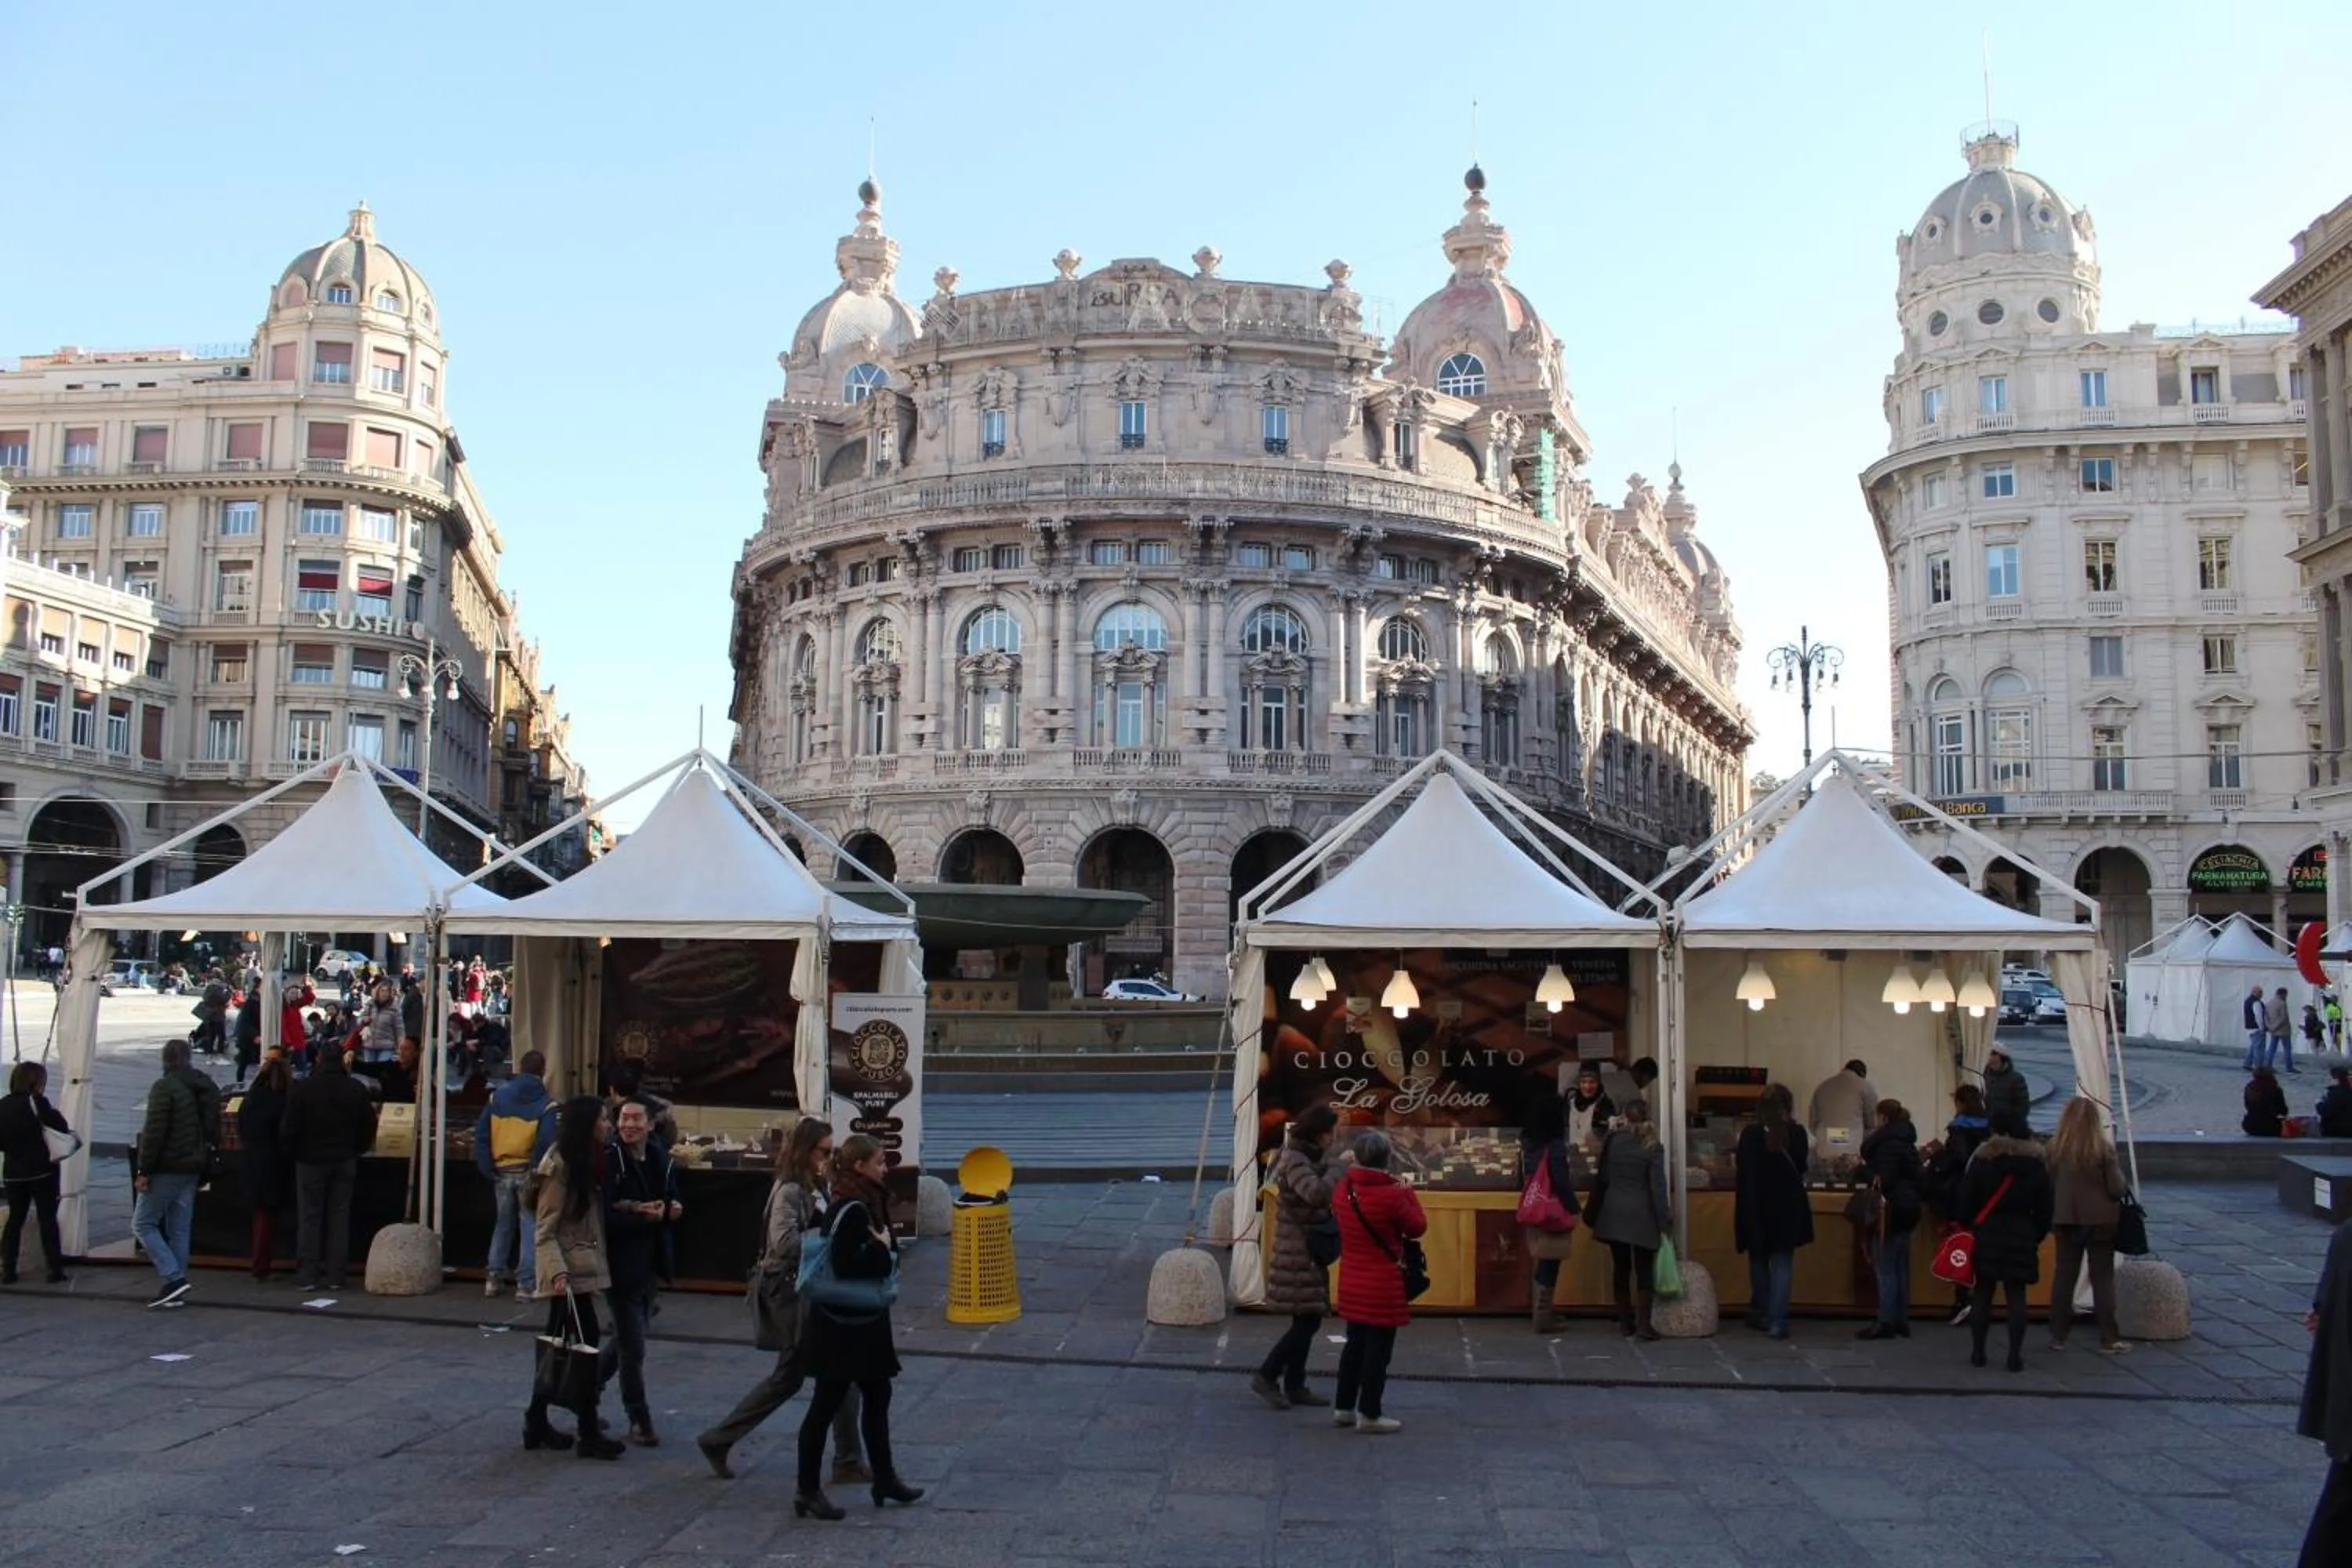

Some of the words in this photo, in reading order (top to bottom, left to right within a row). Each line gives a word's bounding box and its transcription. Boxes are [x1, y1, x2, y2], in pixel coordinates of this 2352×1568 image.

[316, 608, 403, 637] SUSHI
[1947, 801, 1987, 815] Banca
[851, 1022, 906, 1060] CIOCCOLATO
[1294, 1048, 1526, 1069] CIOCCOLATO
[860, 1065, 895, 1080] PURO
[1329, 1076, 1379, 1109] La
[1390, 1075, 1491, 1115] Golosa
